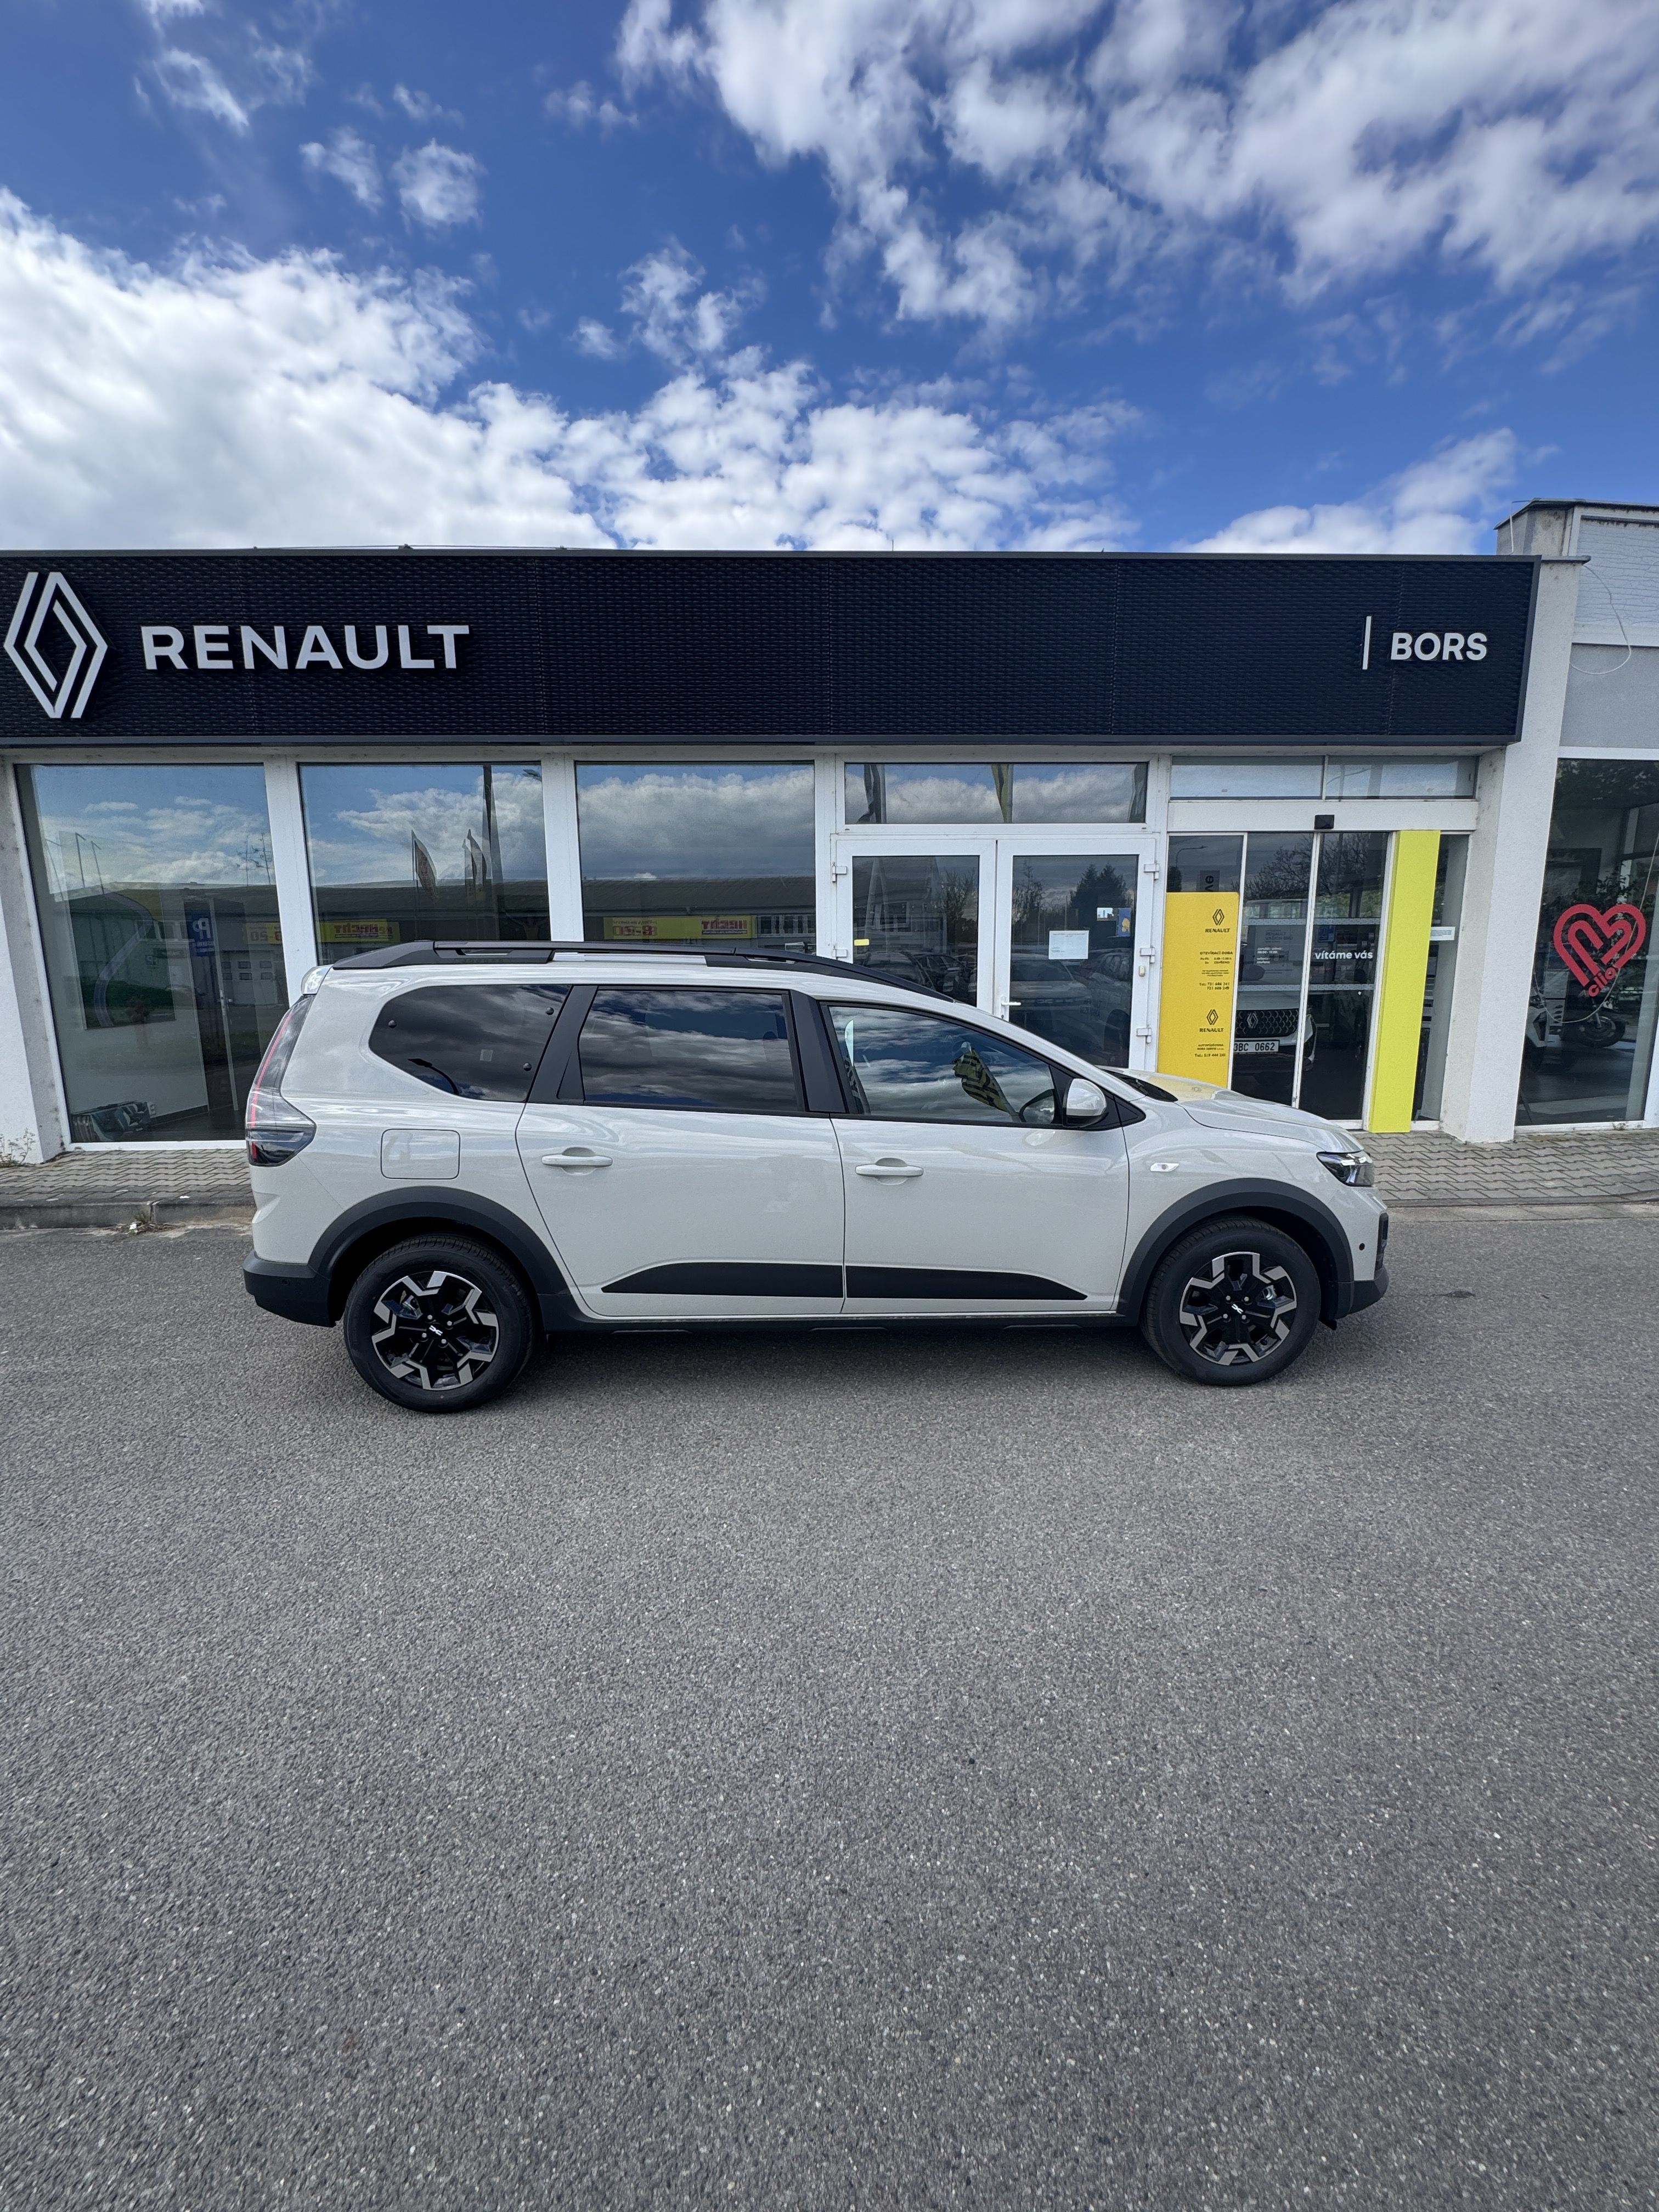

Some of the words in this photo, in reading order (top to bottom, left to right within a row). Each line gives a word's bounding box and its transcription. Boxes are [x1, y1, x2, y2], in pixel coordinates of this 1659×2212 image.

[141, 624, 470, 670] RENAULT
[1390, 632, 1487, 661] BORS
[1314, 950, 1353, 960] vítáme
[1354, 950, 1373, 959] vás
[1588, 967, 1616, 997] clio
[1255, 1042, 1275, 1051] 0662
